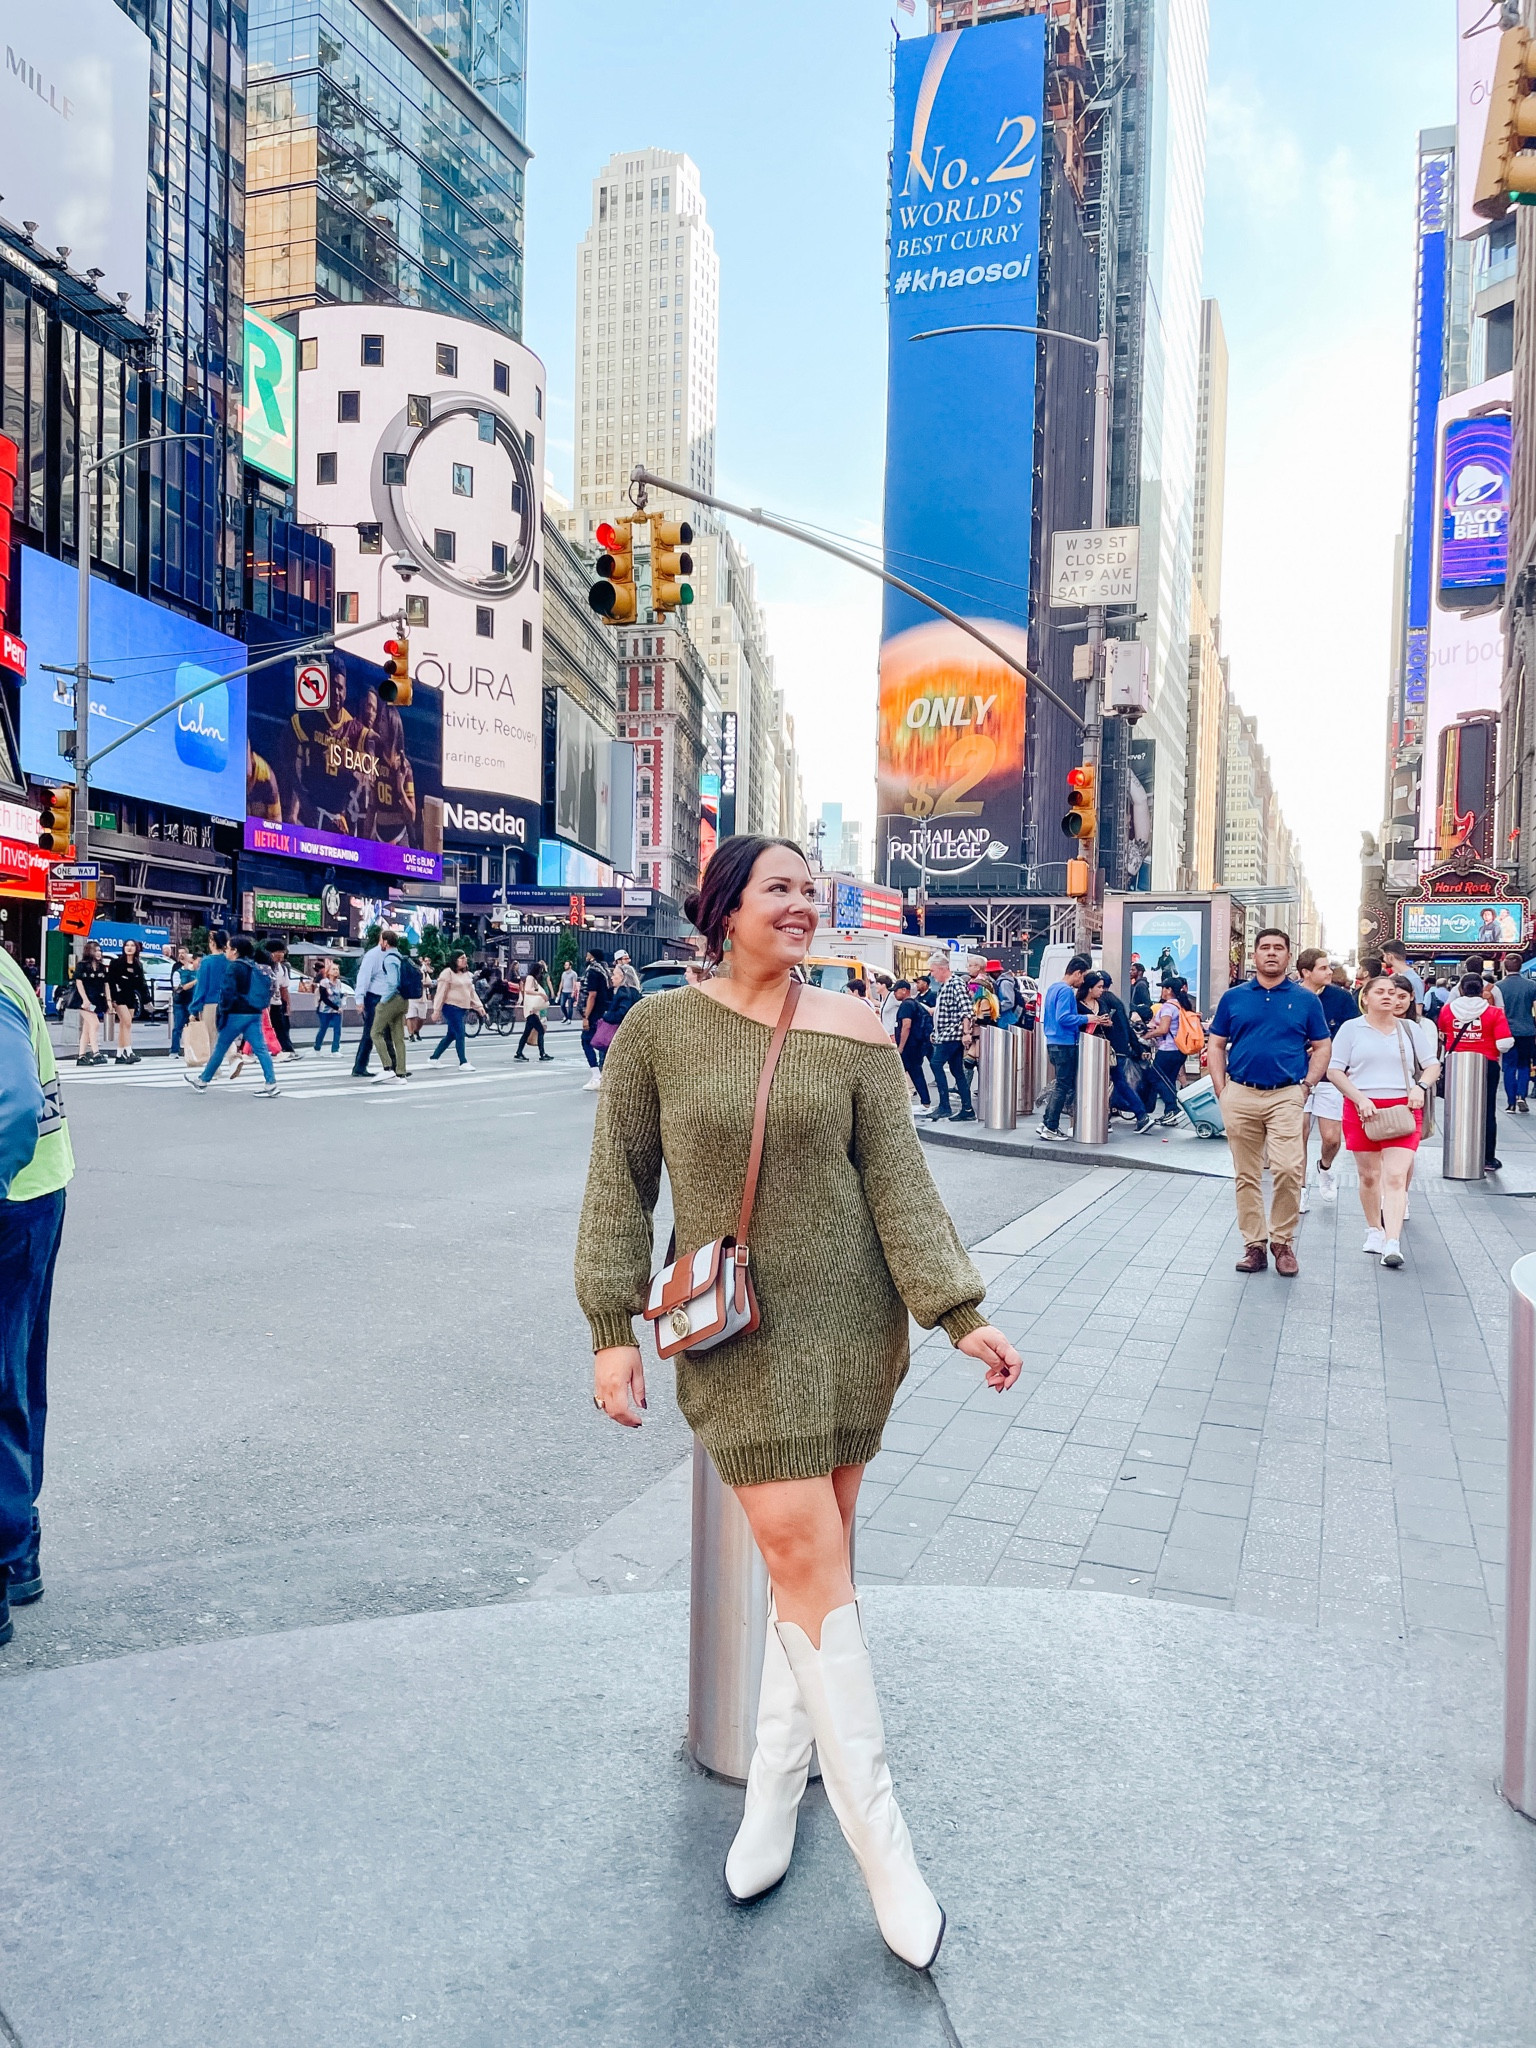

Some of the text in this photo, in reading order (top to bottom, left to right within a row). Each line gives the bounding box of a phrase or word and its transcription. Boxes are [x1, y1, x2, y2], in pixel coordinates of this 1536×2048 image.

[6, 45, 75, 121] MILLE
[898, 115, 1036, 196] No. 2
[899, 188, 1024, 231] WORLD'S
[896, 223, 1024, 258] BEST CURRY
[894, 253, 1032, 294] #khaosoi
[1451, 507, 1502, 526] TACO
[1453, 523, 1502, 541] BELL
[1066, 535, 1128, 551] W 39 ST
[1065, 552, 1127, 567] CLOSED
[1059, 567, 1132, 582] AT 9 AVE
[1058, 585, 1088, 598] SAT
[1100, 583, 1132, 597] SUN
[415, 652, 516, 706] ŌURA
[177, 698, 226, 742] Calm
[906, 694, 998, 729] ONLY
[330, 743, 342, 767] IS
[344, 747, 380, 777] BACK
[445, 751, 506, 769] raring.com
[904, 734, 997, 818] $2
[99, 814, 104, 826] 7
[443, 803, 525, 844] Nasdaq
[254, 829, 290, 853] NETFLIX
[909, 828, 991, 843] THAILAND
[300, 841, 360, 863] NOW STREAMING
[890, 841, 983, 861] PRIVILEGE
[57, 867, 94, 875] ONE WAY
[1434, 881, 1492, 896] Hard Rock
[257, 900, 321, 912] STARBUCKS
[570, 896, 580, 926] BAR
[1408, 905, 1425, 915] NEW
[267, 910, 307, 921] COFFEE
[1408, 913, 1441, 927] MESSI
[521, 924, 561, 934] HOTDOGS
[99, 937, 118, 947] 2030
